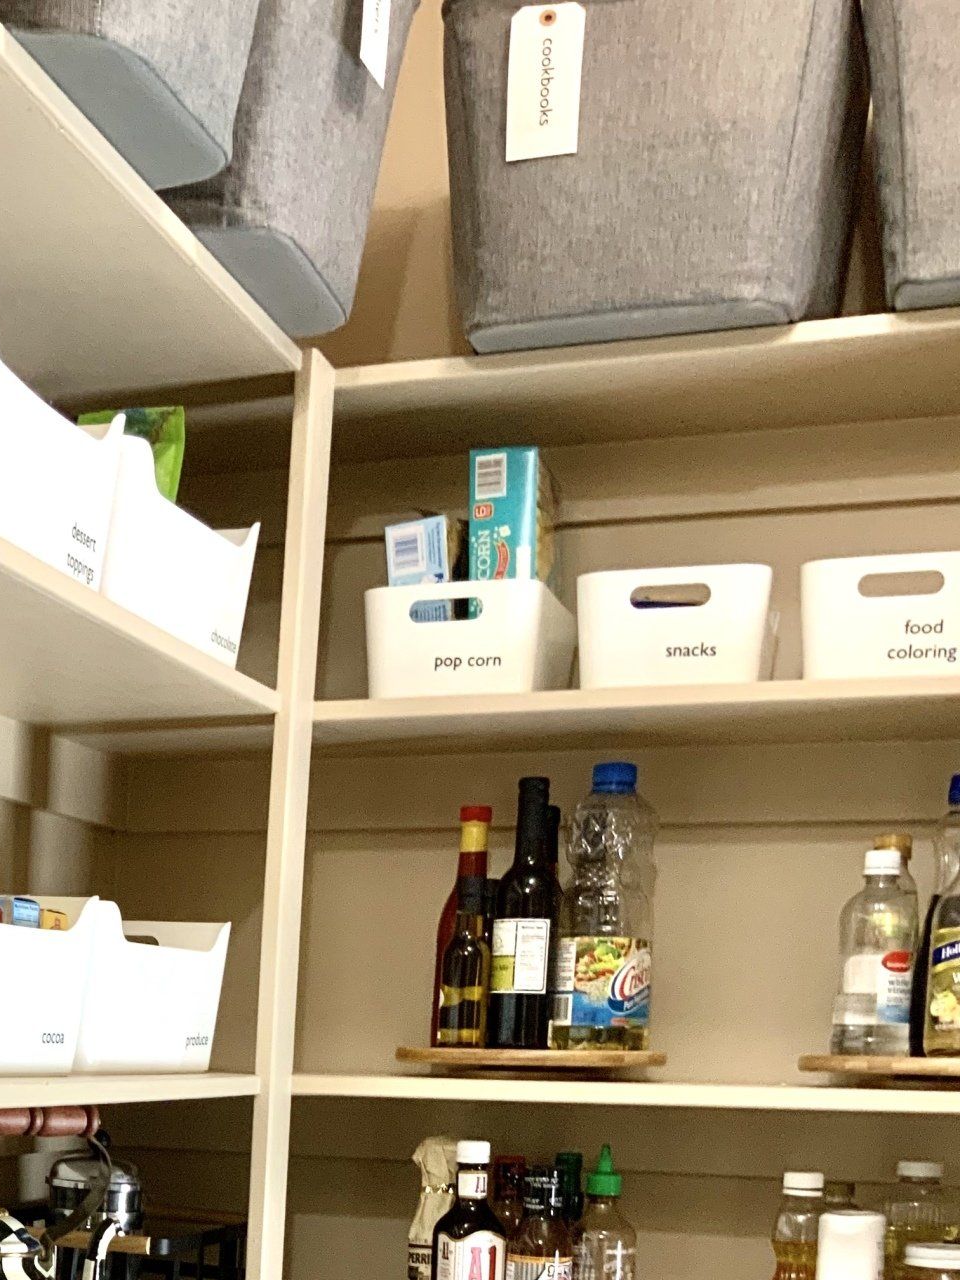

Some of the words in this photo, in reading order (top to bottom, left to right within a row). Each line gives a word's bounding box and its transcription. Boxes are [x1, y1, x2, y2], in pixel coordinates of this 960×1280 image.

[539, 38, 554, 126] cookbooks
[71, 522, 96, 552] dessert
[477, 529, 490, 580] CORN
[67, 553, 95, 584] toppings
[904, 619, 944, 634] food
[665, 642, 717, 658] snacks
[887, 644, 958, 662] coloring
[434, 656, 463, 671] pop
[467, 655, 502, 667] corn
[42, 1032, 65, 1044] cocoa
[185, 1033, 209, 1050] produce
